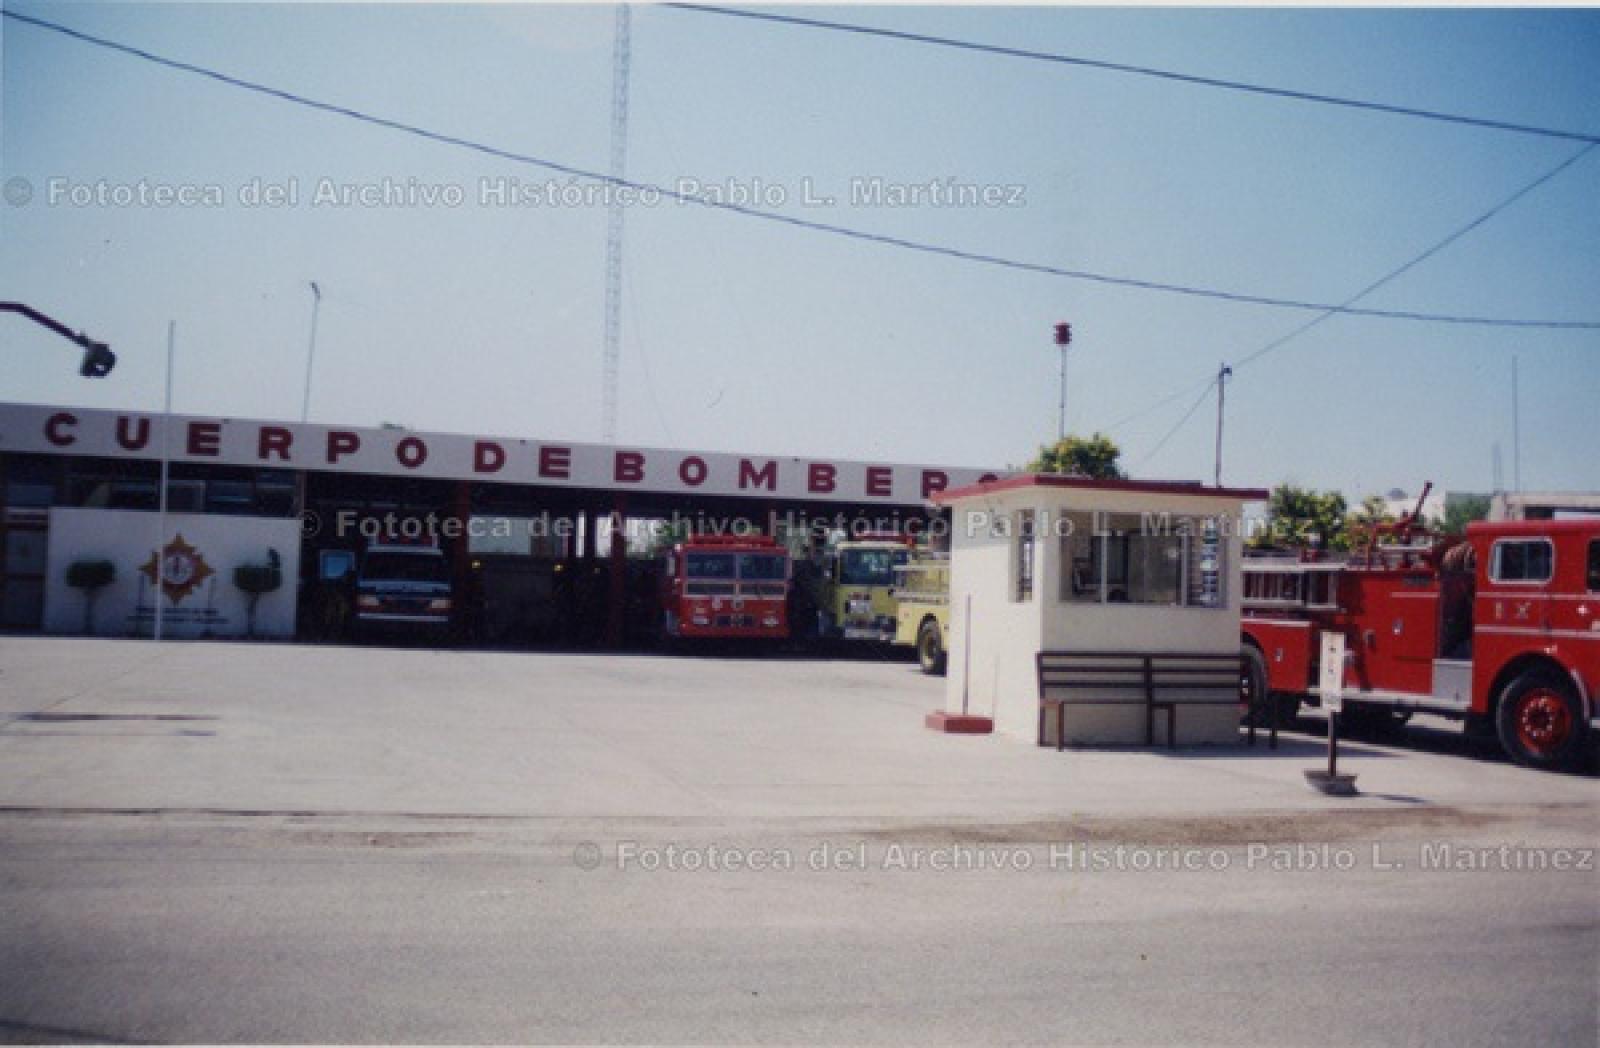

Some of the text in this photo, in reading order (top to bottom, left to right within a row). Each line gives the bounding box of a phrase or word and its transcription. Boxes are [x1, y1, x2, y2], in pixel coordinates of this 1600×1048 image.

[45, 412, 998, 498] CUERPO DE BOMBER
